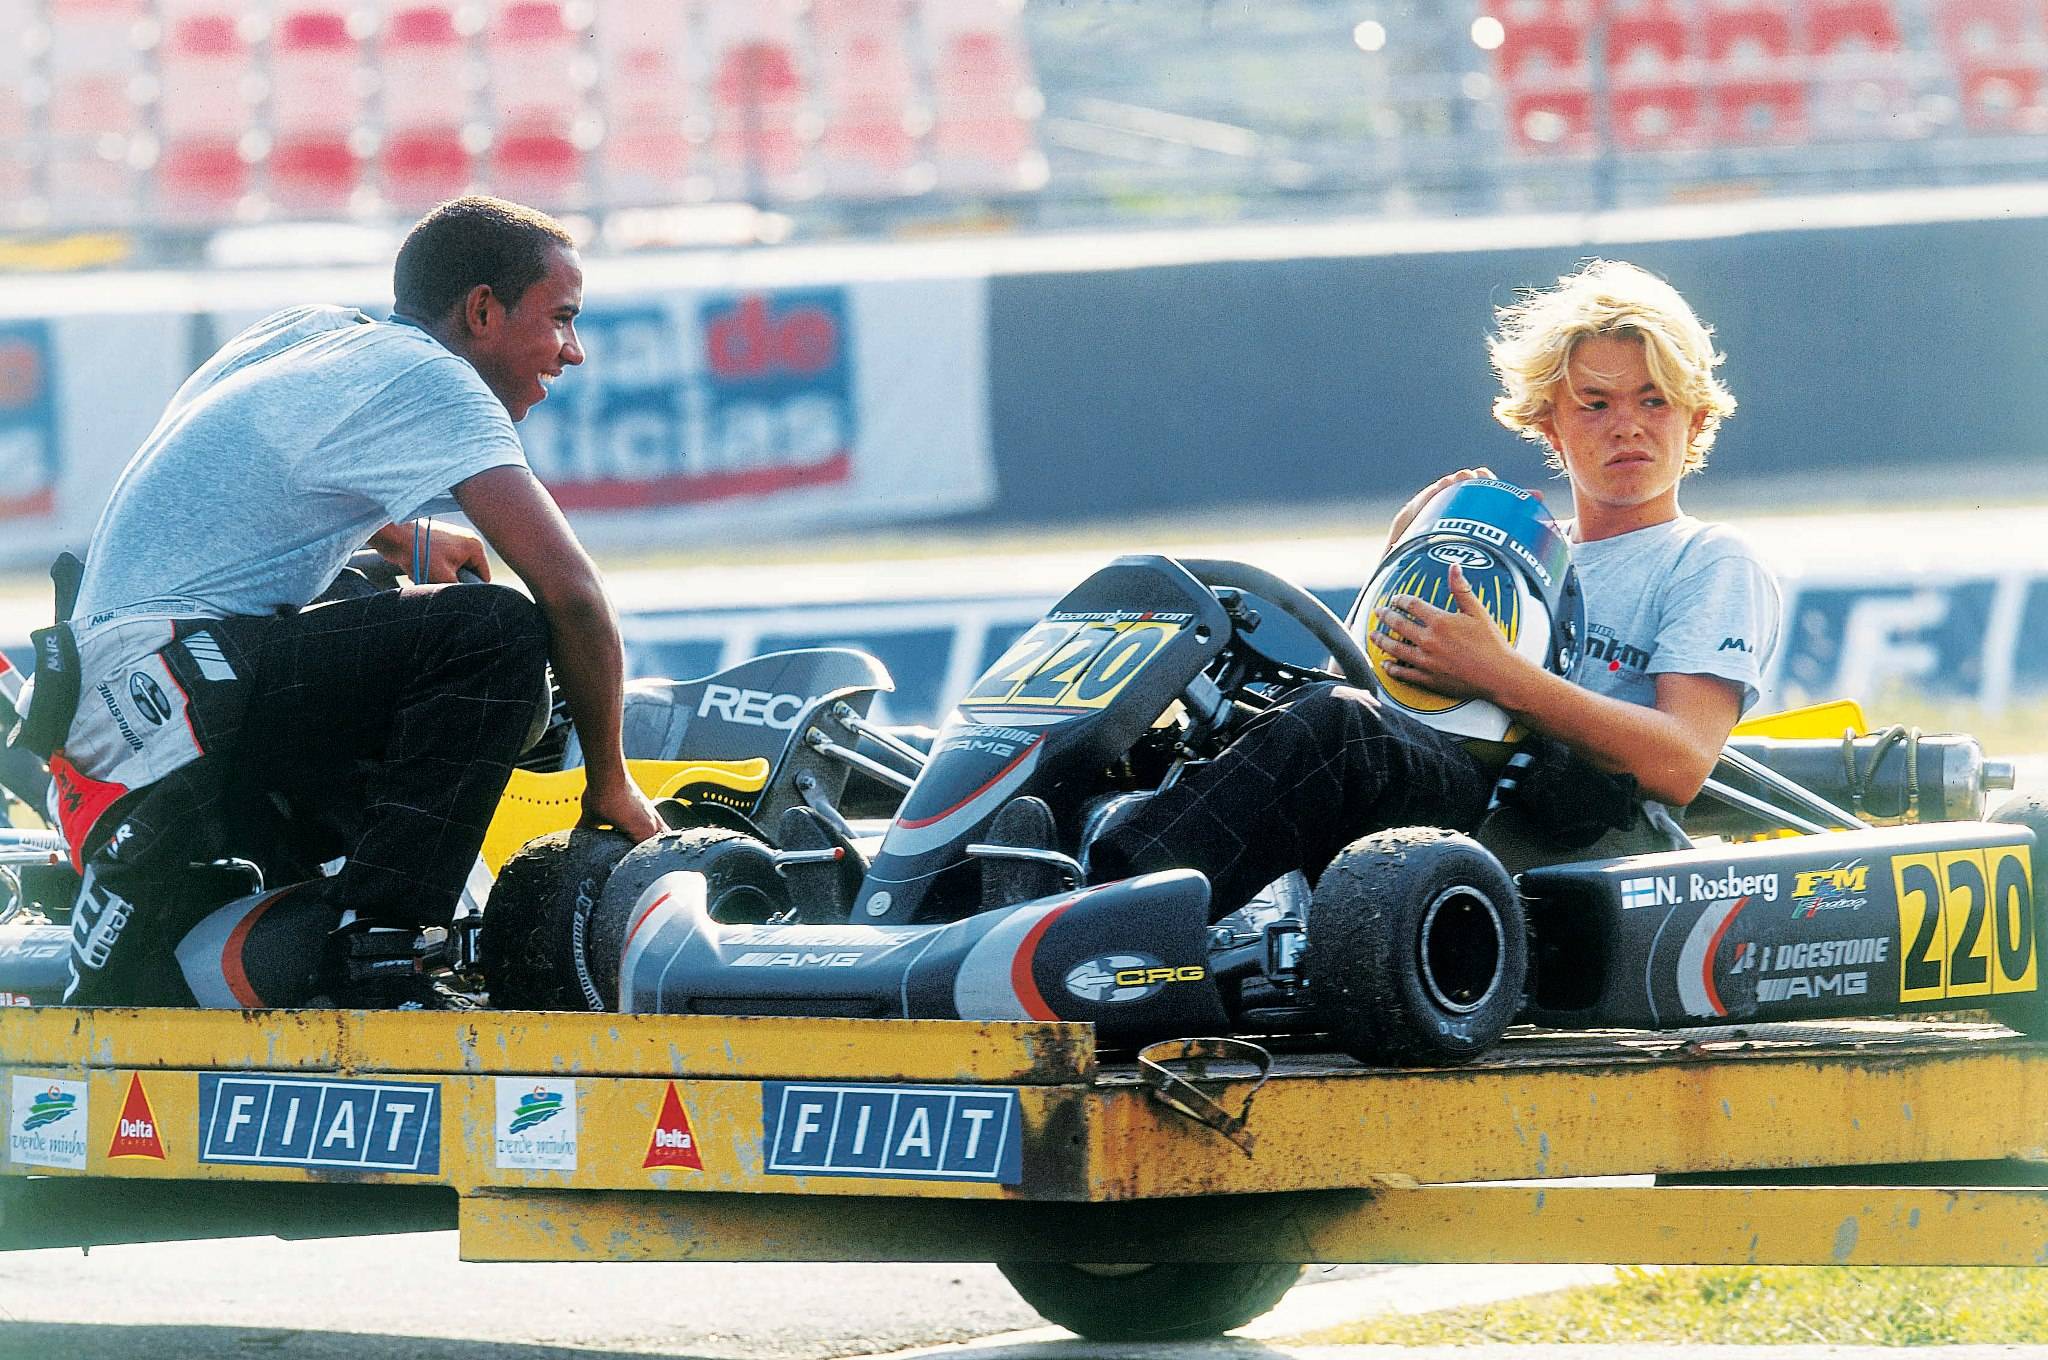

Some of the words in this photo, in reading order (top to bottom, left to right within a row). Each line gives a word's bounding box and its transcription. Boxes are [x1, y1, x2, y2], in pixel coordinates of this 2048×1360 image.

[1438, 546, 1484, 565] Arai
[966, 627, 1165, 701] 220
[1655, 876, 1683, 905] N.
[1690, 865, 1779, 902] Rosberg
[1901, 854, 2033, 990] 220
[766, 952, 864, 968] AMG
[1115, 965, 1205, 987] CRG
[1783, 971, 1868, 1000] AMG
[120, 1118, 153, 1138] Delta
[223, 1095, 416, 1152] FIAT
[791, 1103, 995, 1160] FIAT
[655, 1128, 691, 1149] Delta
